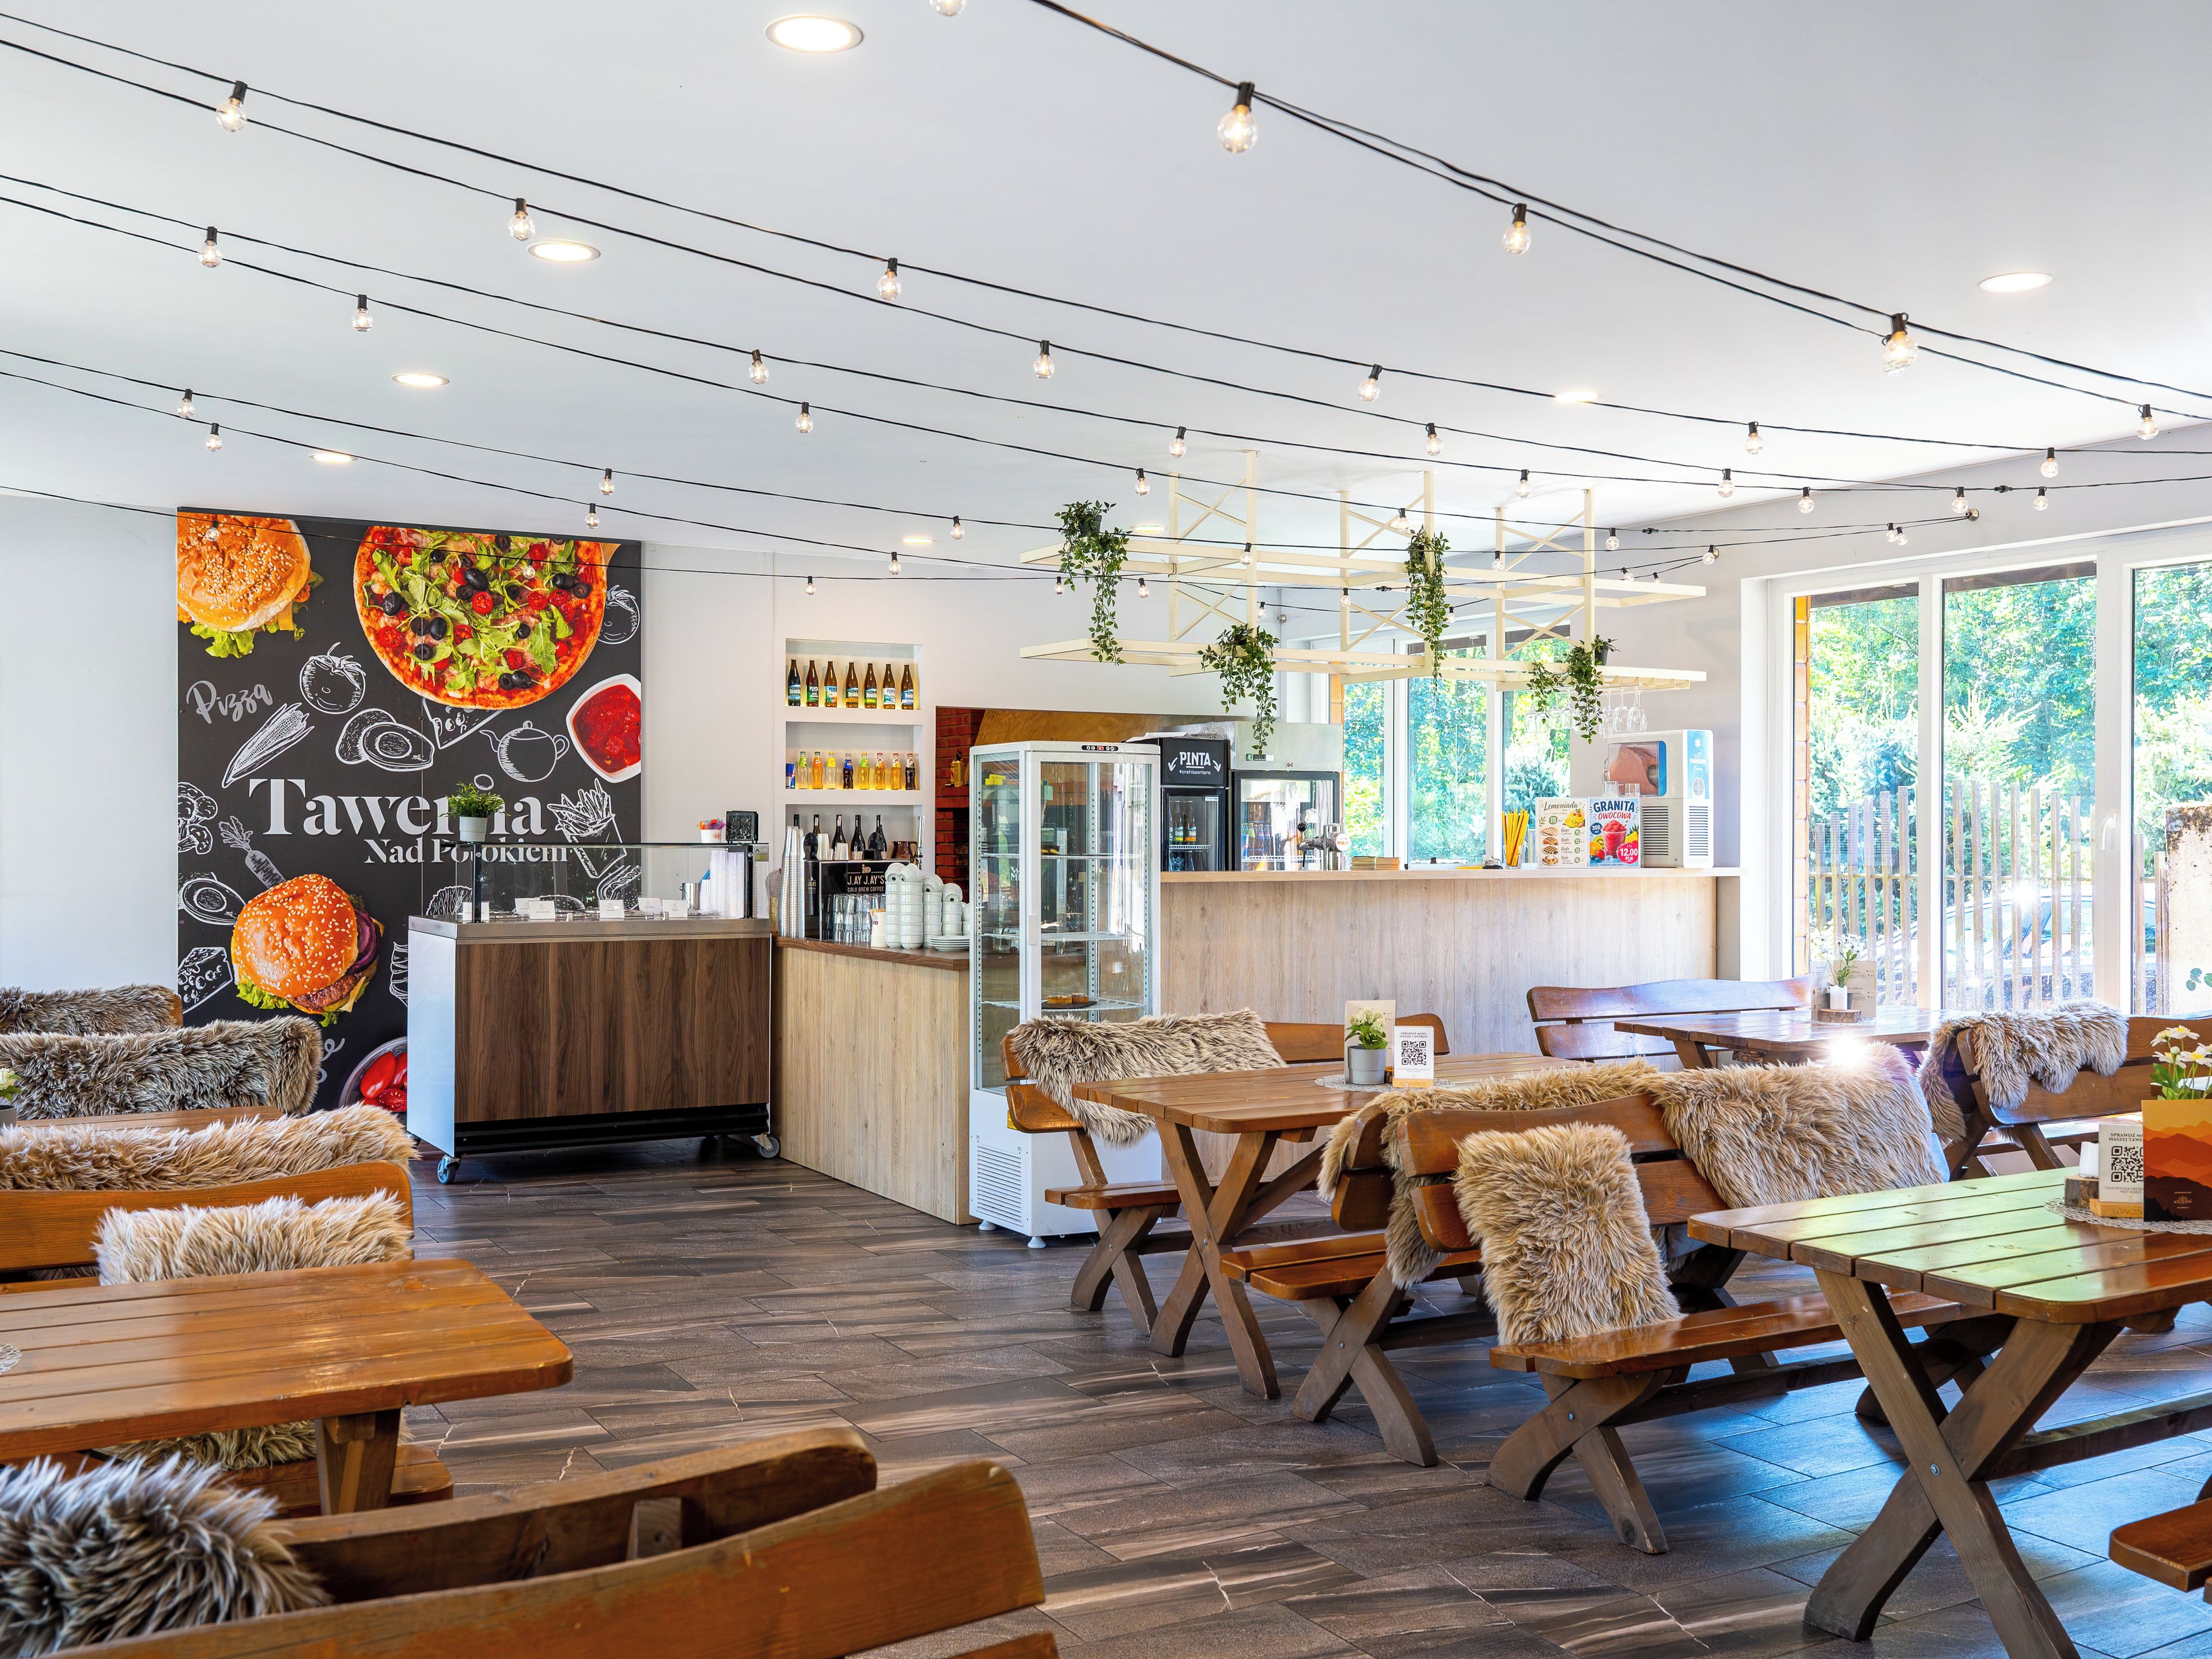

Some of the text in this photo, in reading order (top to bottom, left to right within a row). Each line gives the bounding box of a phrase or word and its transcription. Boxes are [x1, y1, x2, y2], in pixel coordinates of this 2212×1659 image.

[186, 680, 273, 724] Pizza
[1179, 752, 1211, 766] PINTA
[1544, 801, 1578, 811] Lemoniada
[1593, 800, 1635, 813] GRANITA
[1598, 812, 1631, 820] OWOCOWA
[364, 837, 568, 863] Nad Pookiem
[1620, 848, 1638, 856] 12,00
[847, 875, 885, 885] J.AY J.AY'S
